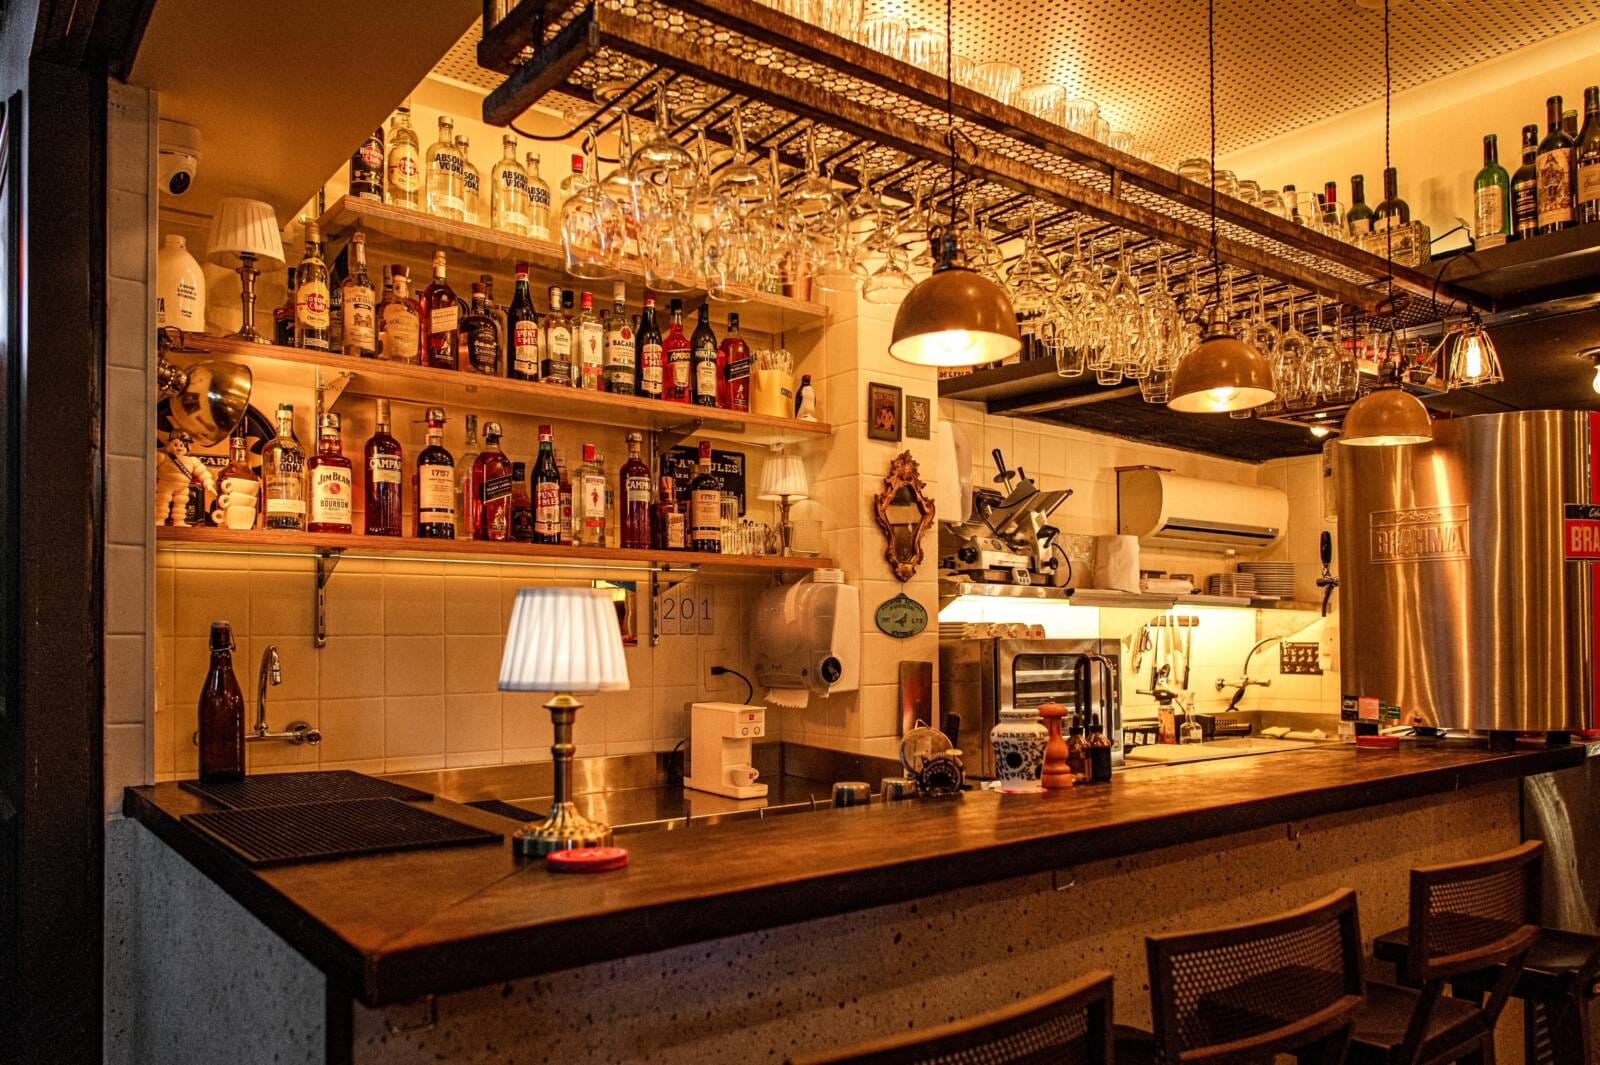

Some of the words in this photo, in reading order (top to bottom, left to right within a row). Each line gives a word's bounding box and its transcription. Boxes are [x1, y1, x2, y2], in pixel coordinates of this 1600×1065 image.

[435, 153, 464, 167] ABSOLU
[502, 170, 529, 184] ABSOLU
[280, 464, 303, 474] ODKA
[369, 459, 401, 470] CAMPA
[318, 474, 331, 485] JIM
[320, 500, 348, 509] BOURBON
[1376, 526, 1467, 557] BRAHMA
[662, 598, 712, 621] 201
